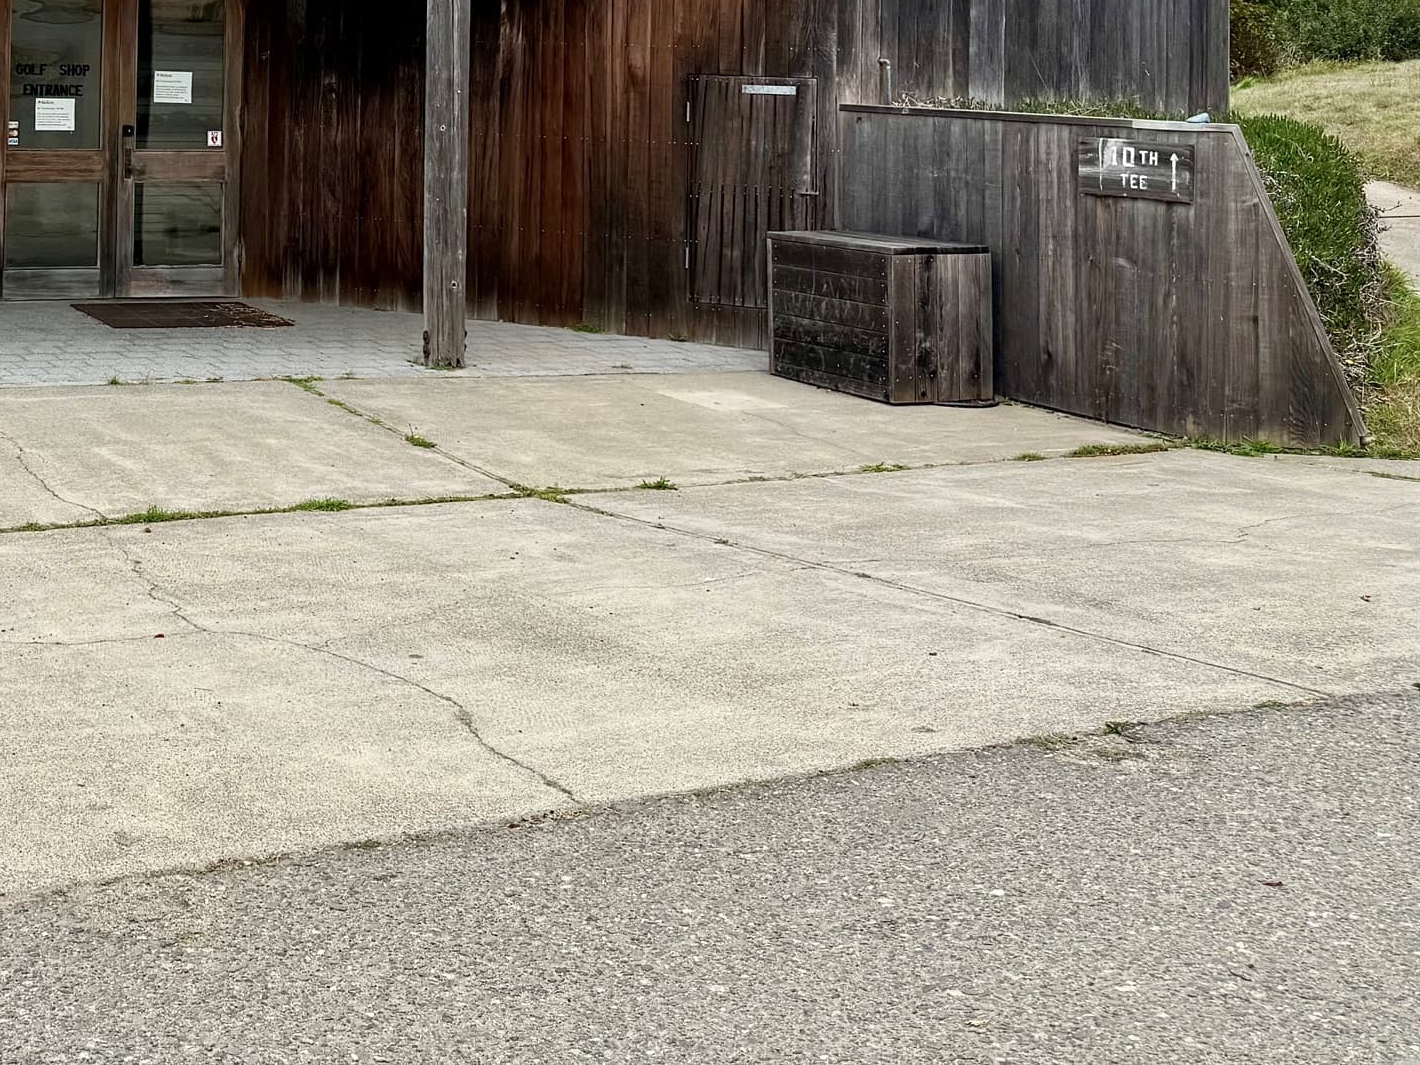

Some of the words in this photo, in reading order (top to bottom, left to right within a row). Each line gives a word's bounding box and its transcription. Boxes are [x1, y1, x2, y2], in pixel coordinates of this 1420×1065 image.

[15, 63, 47, 76] GOLF
[59, 64, 90, 76] SHOP
[22, 84, 84, 97] ENTRANCE
[1120, 173, 1148, 190] TEE
